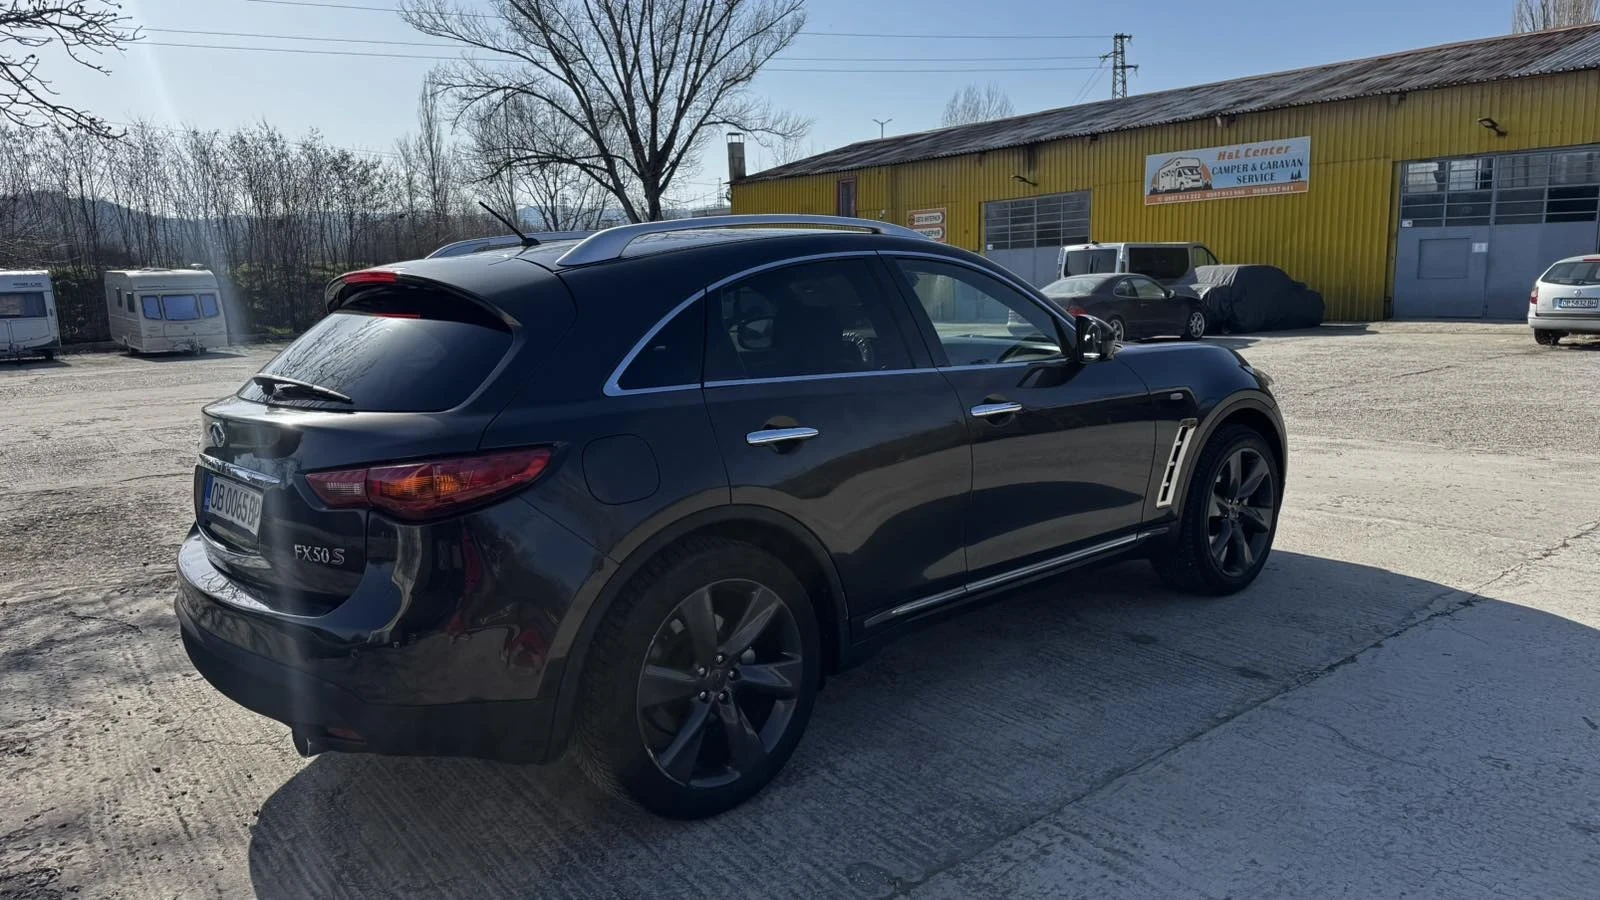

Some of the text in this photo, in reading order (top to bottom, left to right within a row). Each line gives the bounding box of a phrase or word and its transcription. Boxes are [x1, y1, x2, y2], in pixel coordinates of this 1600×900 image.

[1244, 145, 1291, 158] Center
[1212, 158, 1304, 175] CAMPER & CARAVAN
[1236, 172, 1276, 185] SERVICE
[211, 482, 261, 528] OB 0065 BP
[294, 544, 345, 565] FX50 S
